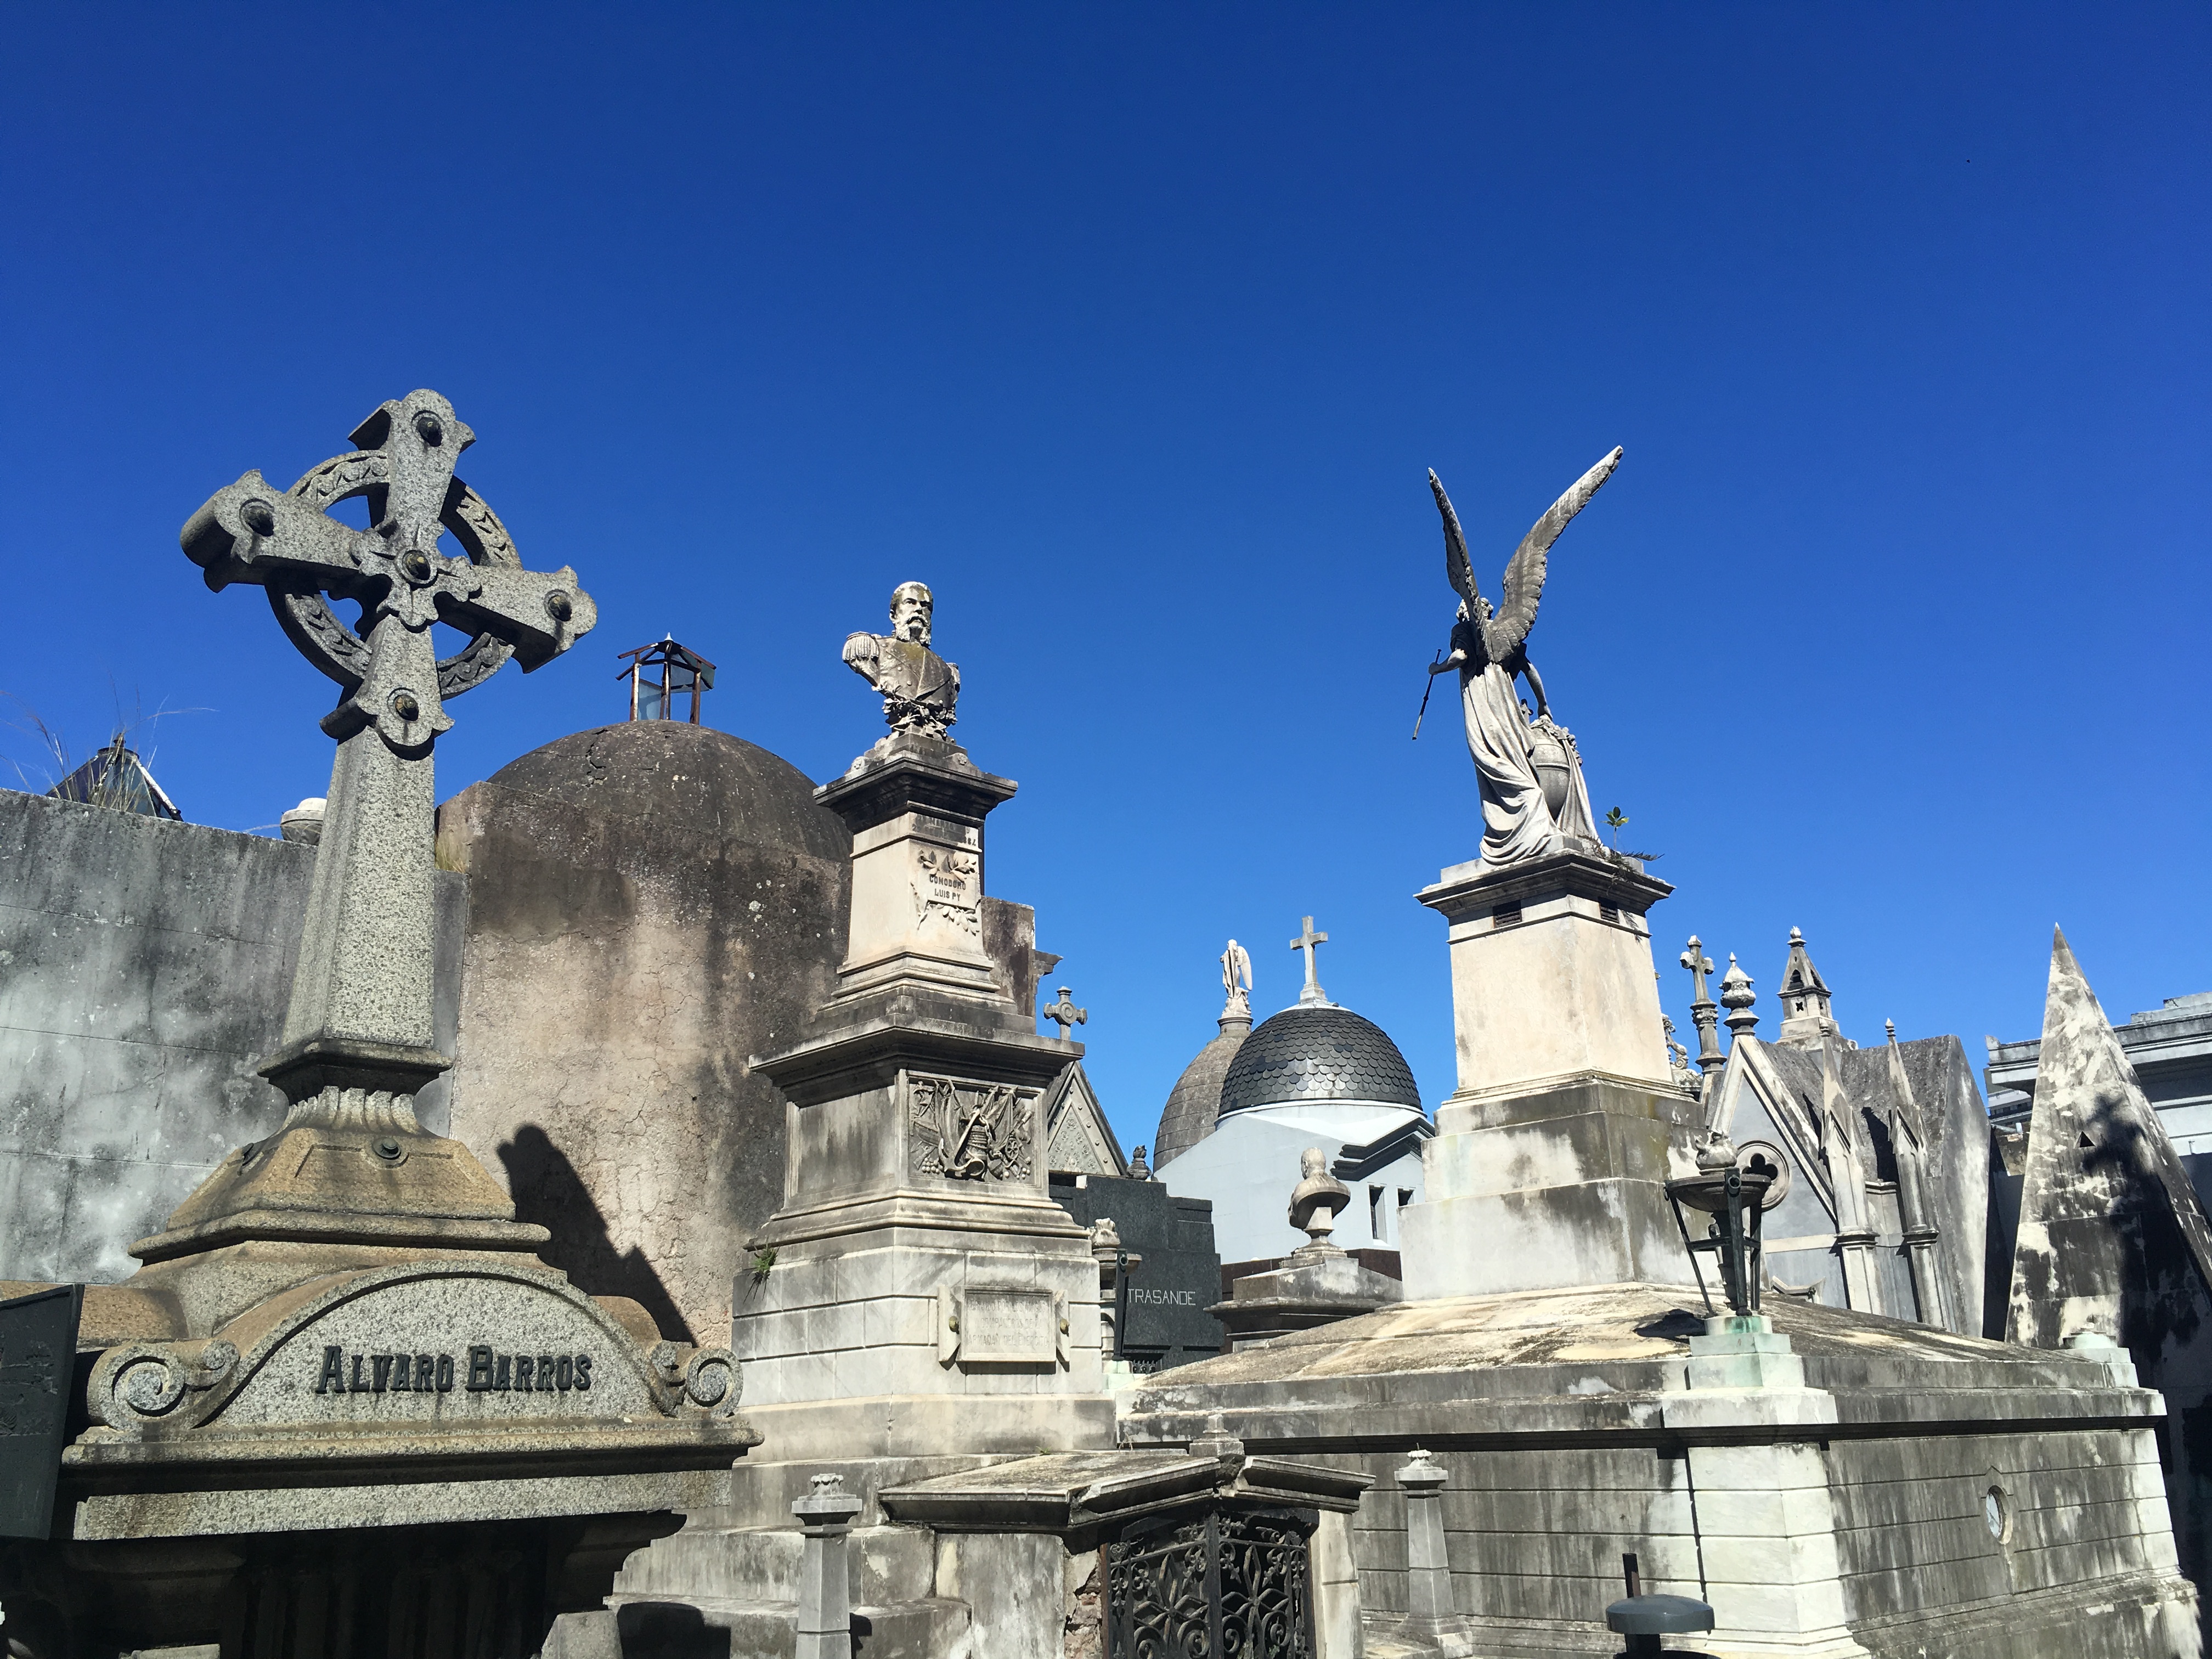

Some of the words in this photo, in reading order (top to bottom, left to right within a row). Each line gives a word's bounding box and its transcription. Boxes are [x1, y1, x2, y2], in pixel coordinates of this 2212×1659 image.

[929, 874, 966, 890] COMODORO
[934, 888, 950, 899] LUIS
[952, 892, 961, 901] PY
[1127, 1288, 1196, 1306] TRASANDE
[1025, 1318, 1033, 1329] DE
[968, 1334, 996, 1346] ARMADA
[1003, 1335, 1016, 1346] DEL
[315, 1345, 454, 1394] ALVARO
[465, 1344, 592, 1392] BARROS
